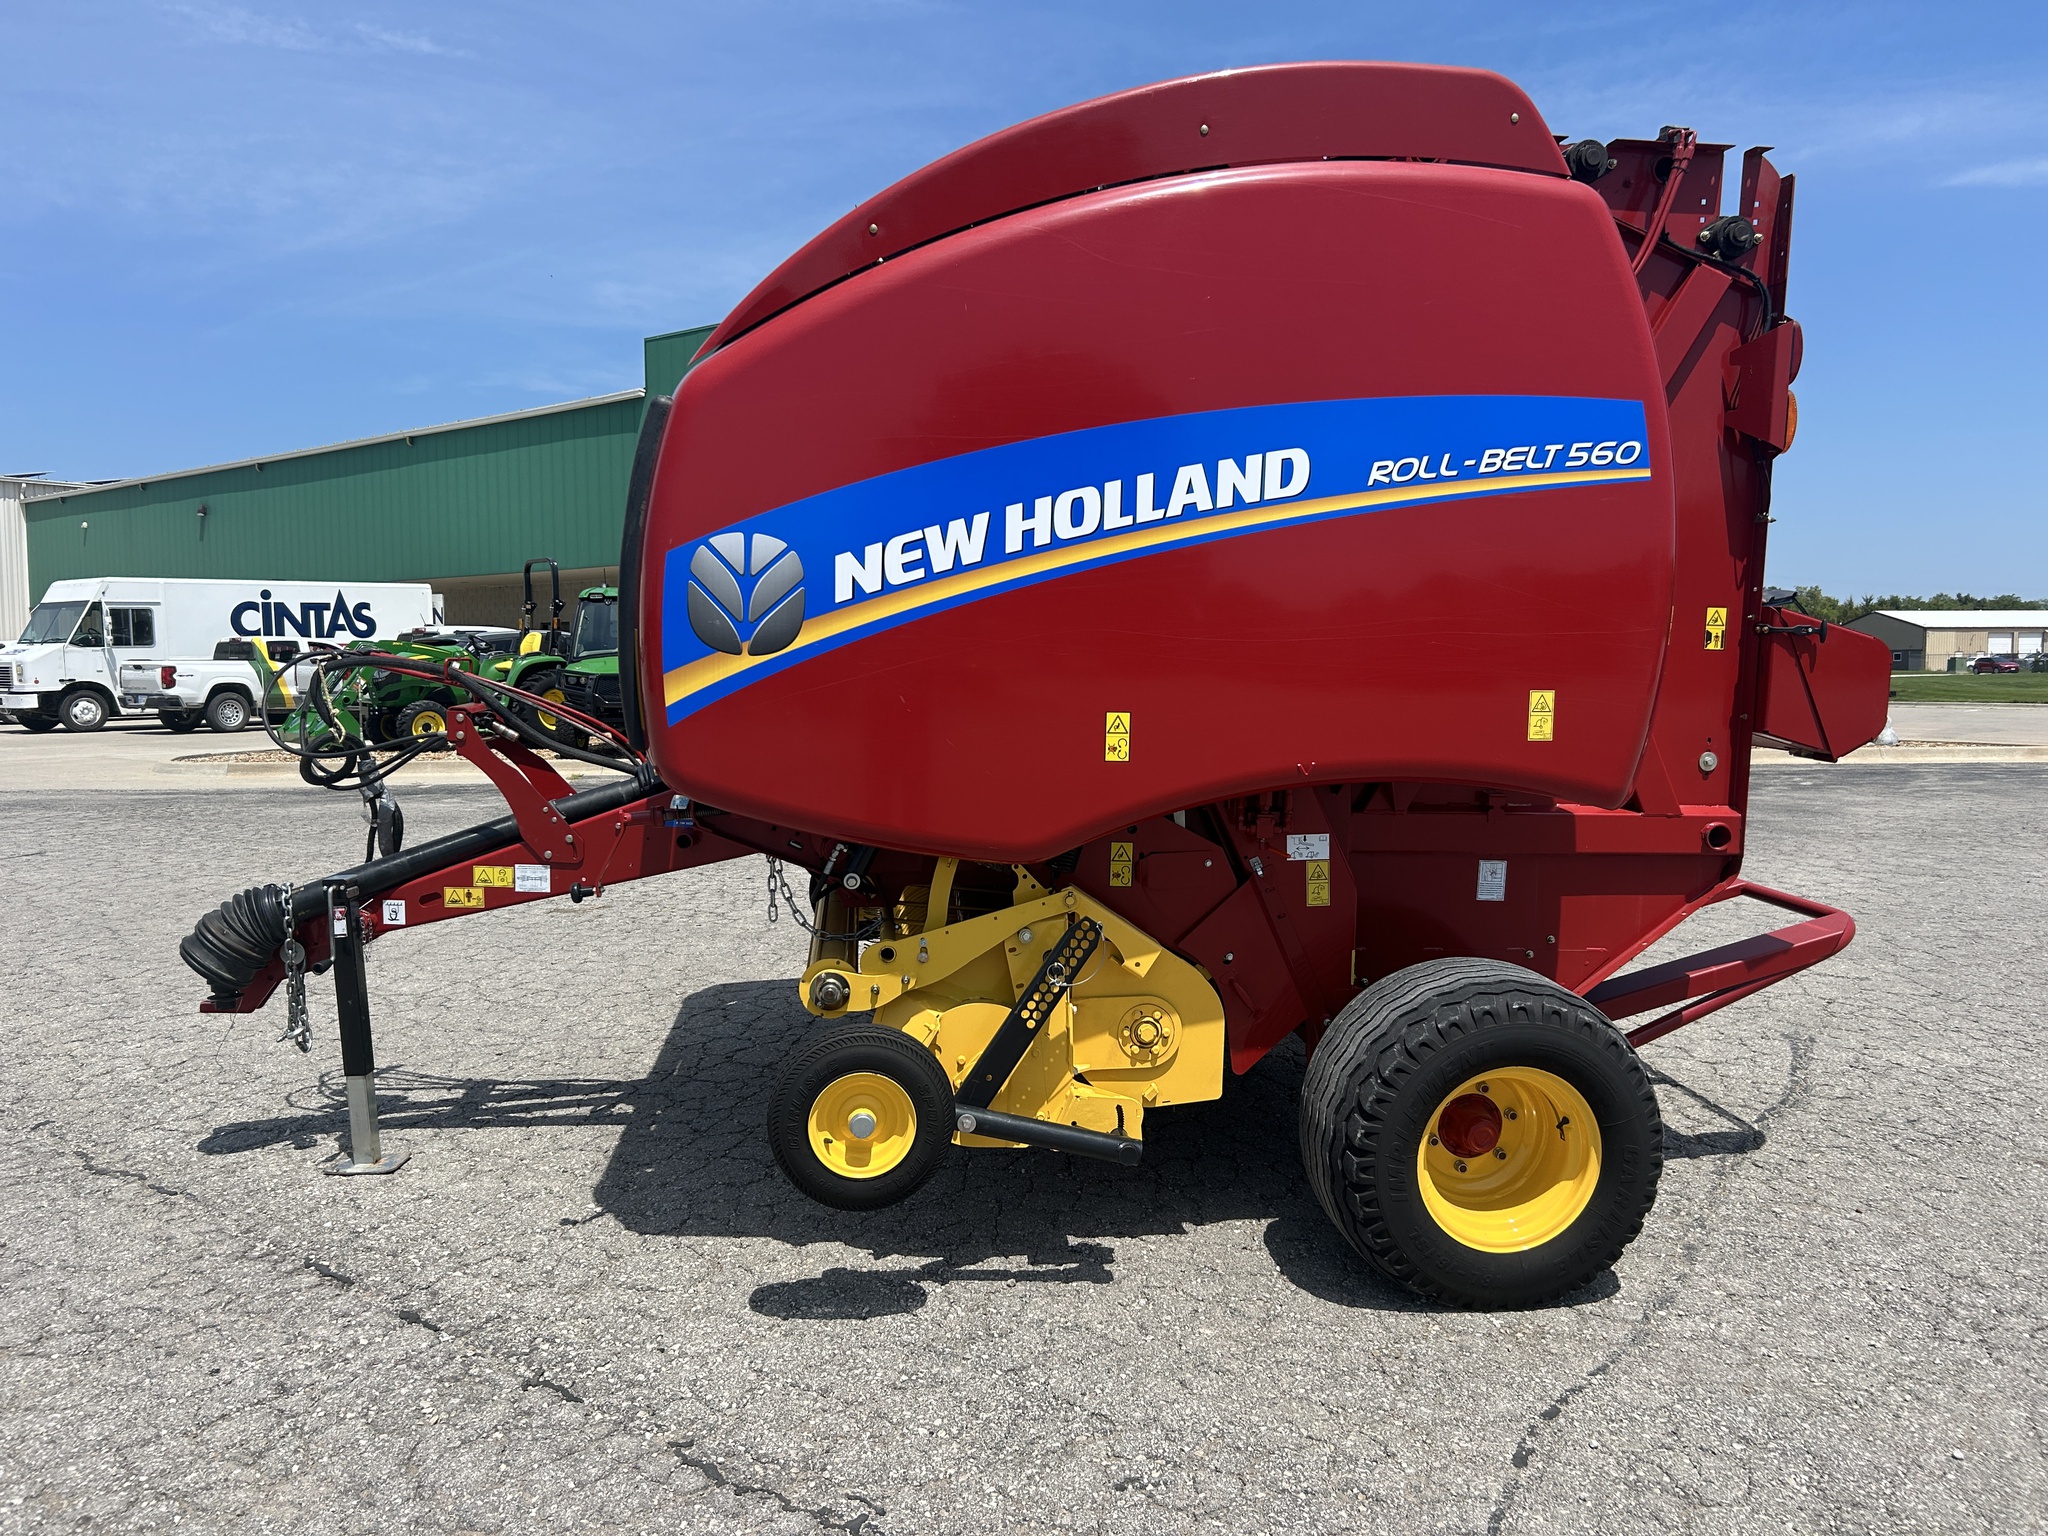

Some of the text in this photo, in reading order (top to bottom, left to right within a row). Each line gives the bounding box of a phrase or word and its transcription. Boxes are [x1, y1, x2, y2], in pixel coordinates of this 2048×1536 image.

[1566, 440, 1643, 468] 560
[834, 447, 1311, 604] NEW HOLLAND
[788, 1058, 839, 1150] CARLISLE
[874, 1083, 939, 1197] SPORT TRAIL
[1389, 1038, 1496, 1203] IMPLEMENT
[1553, 1144, 1641, 1280] CARLISLE
